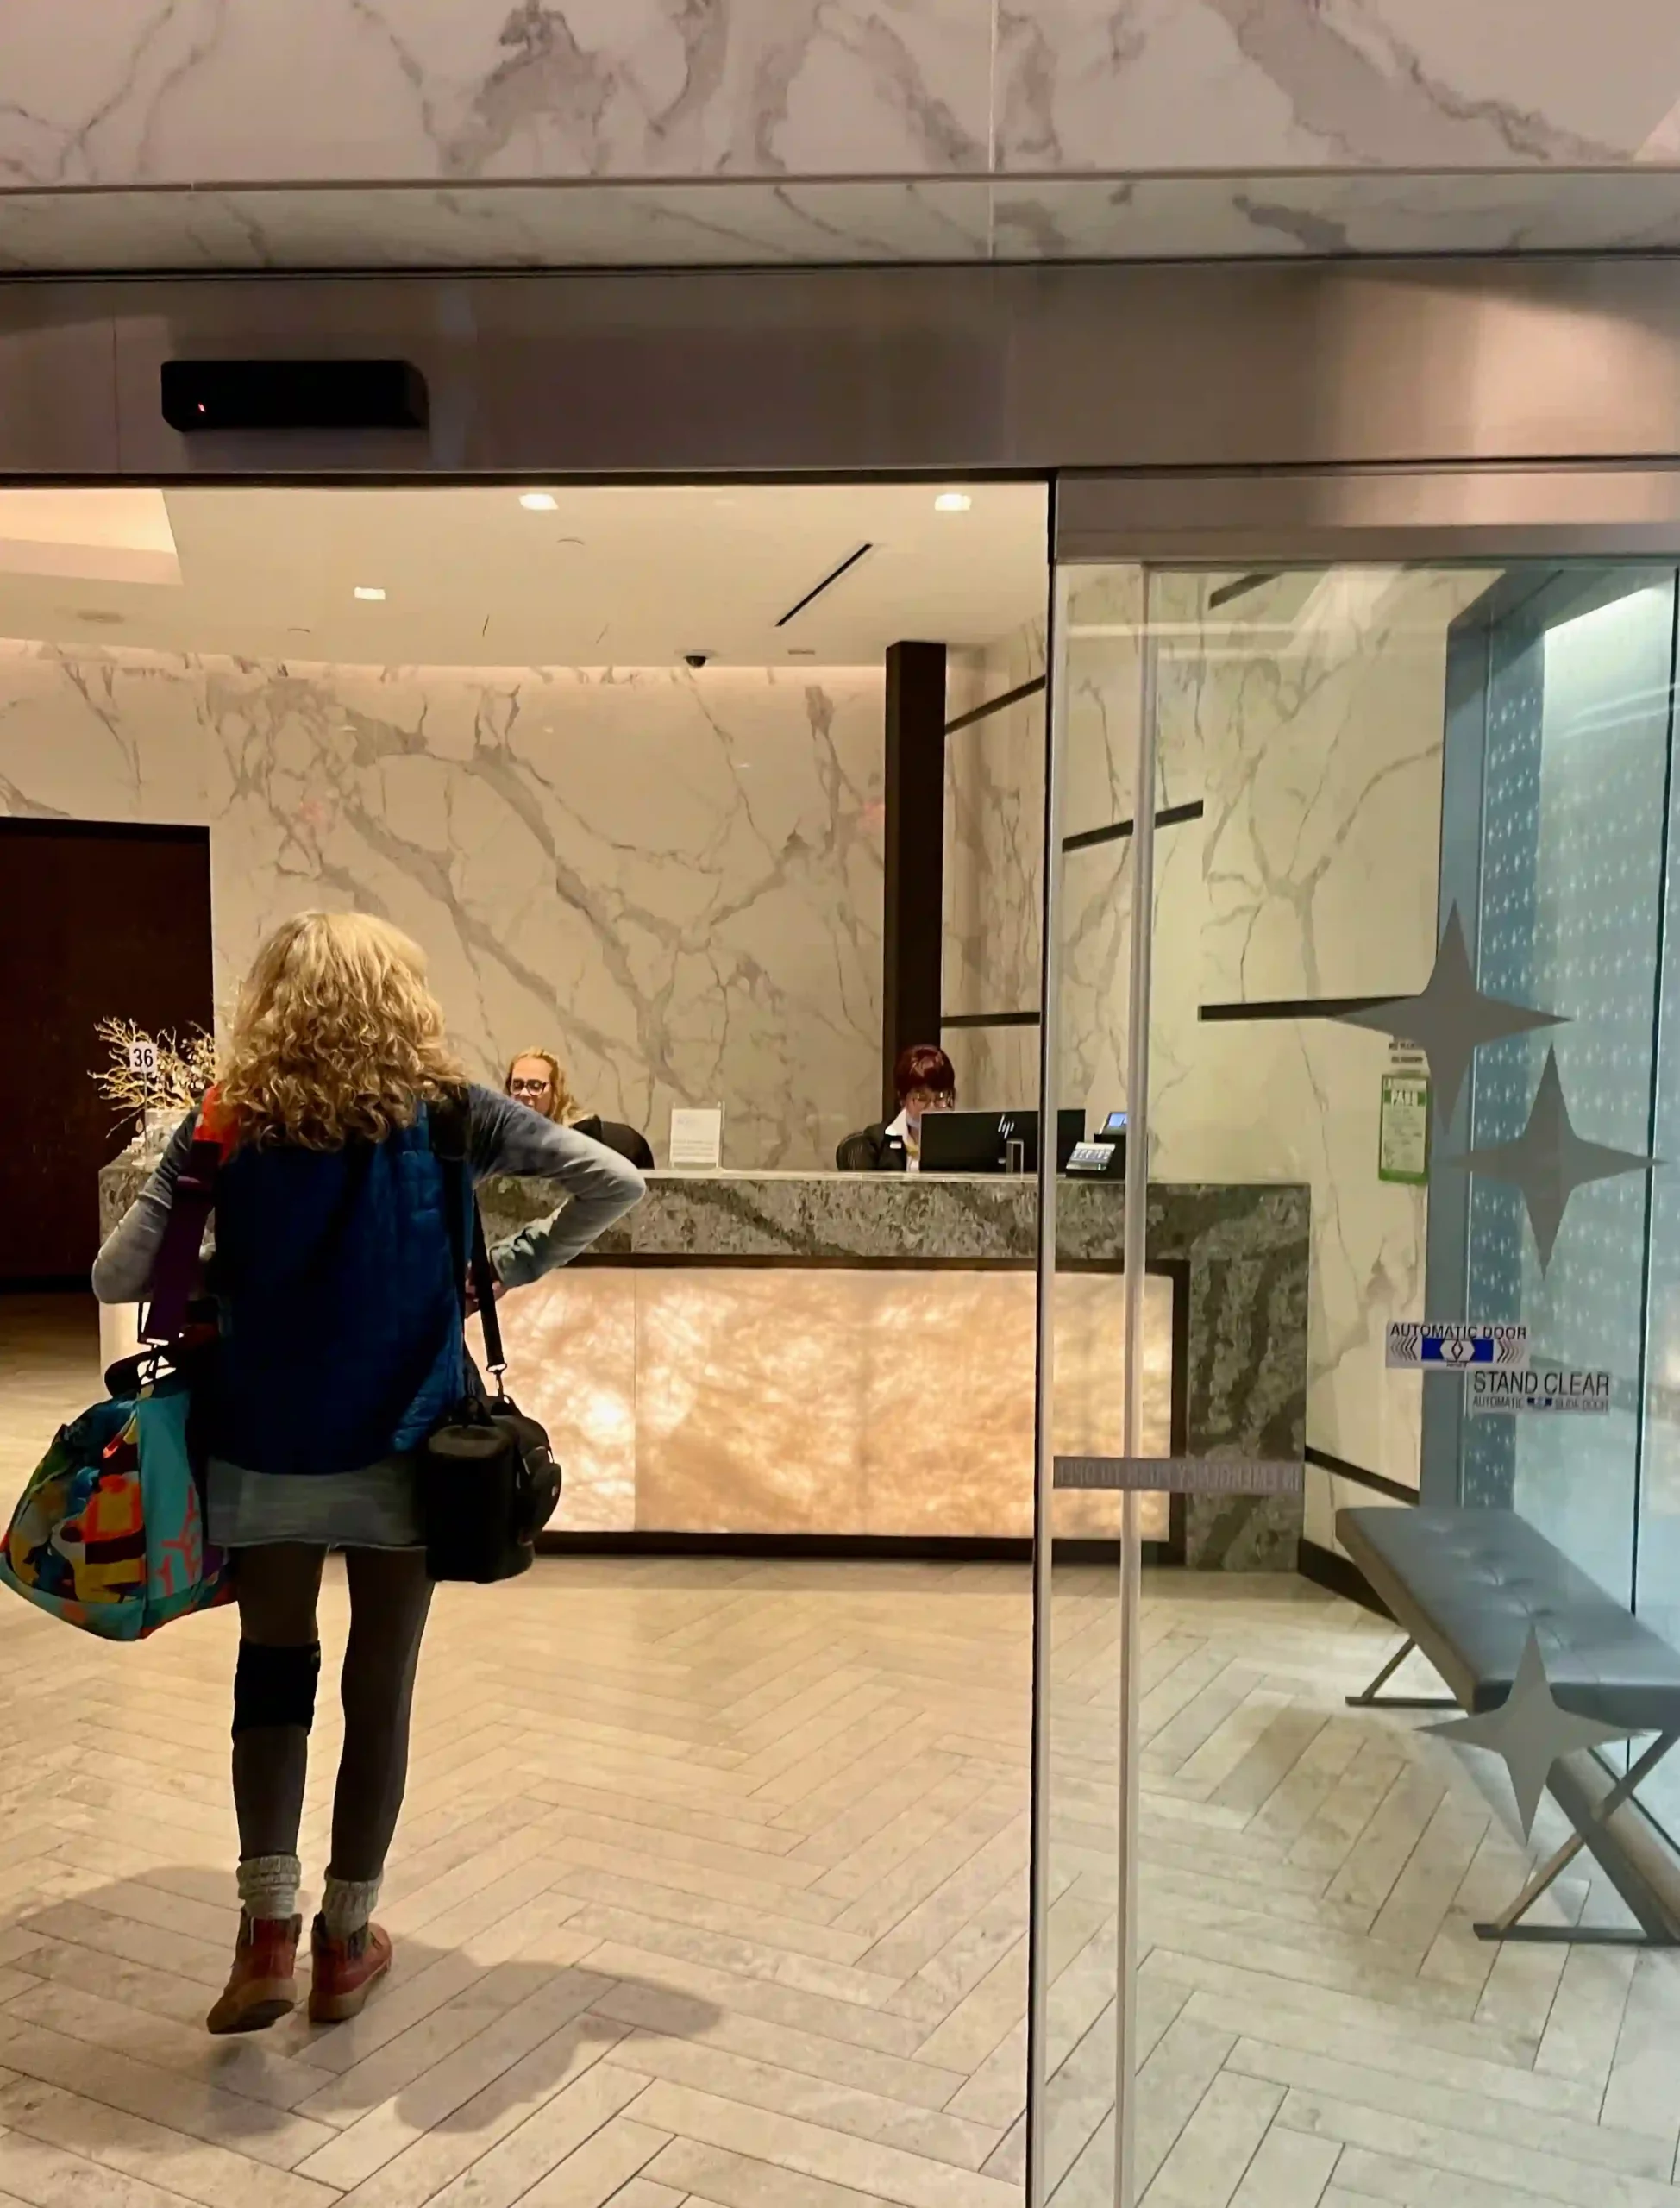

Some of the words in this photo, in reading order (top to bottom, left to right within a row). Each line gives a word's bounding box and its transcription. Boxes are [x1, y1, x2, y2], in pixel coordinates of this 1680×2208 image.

[133, 1048, 154, 1068] 36
[998, 1113, 1015, 1138] hp
[1390, 1322, 1477, 1340] AUTOMATIC
[1483, 1326, 1527, 1340] DOOR
[1473, 1371, 1539, 1394] STAND
[1544, 1371, 1610, 1396] CLEAR
[1472, 1396, 1524, 1410] AUTOMATIC
